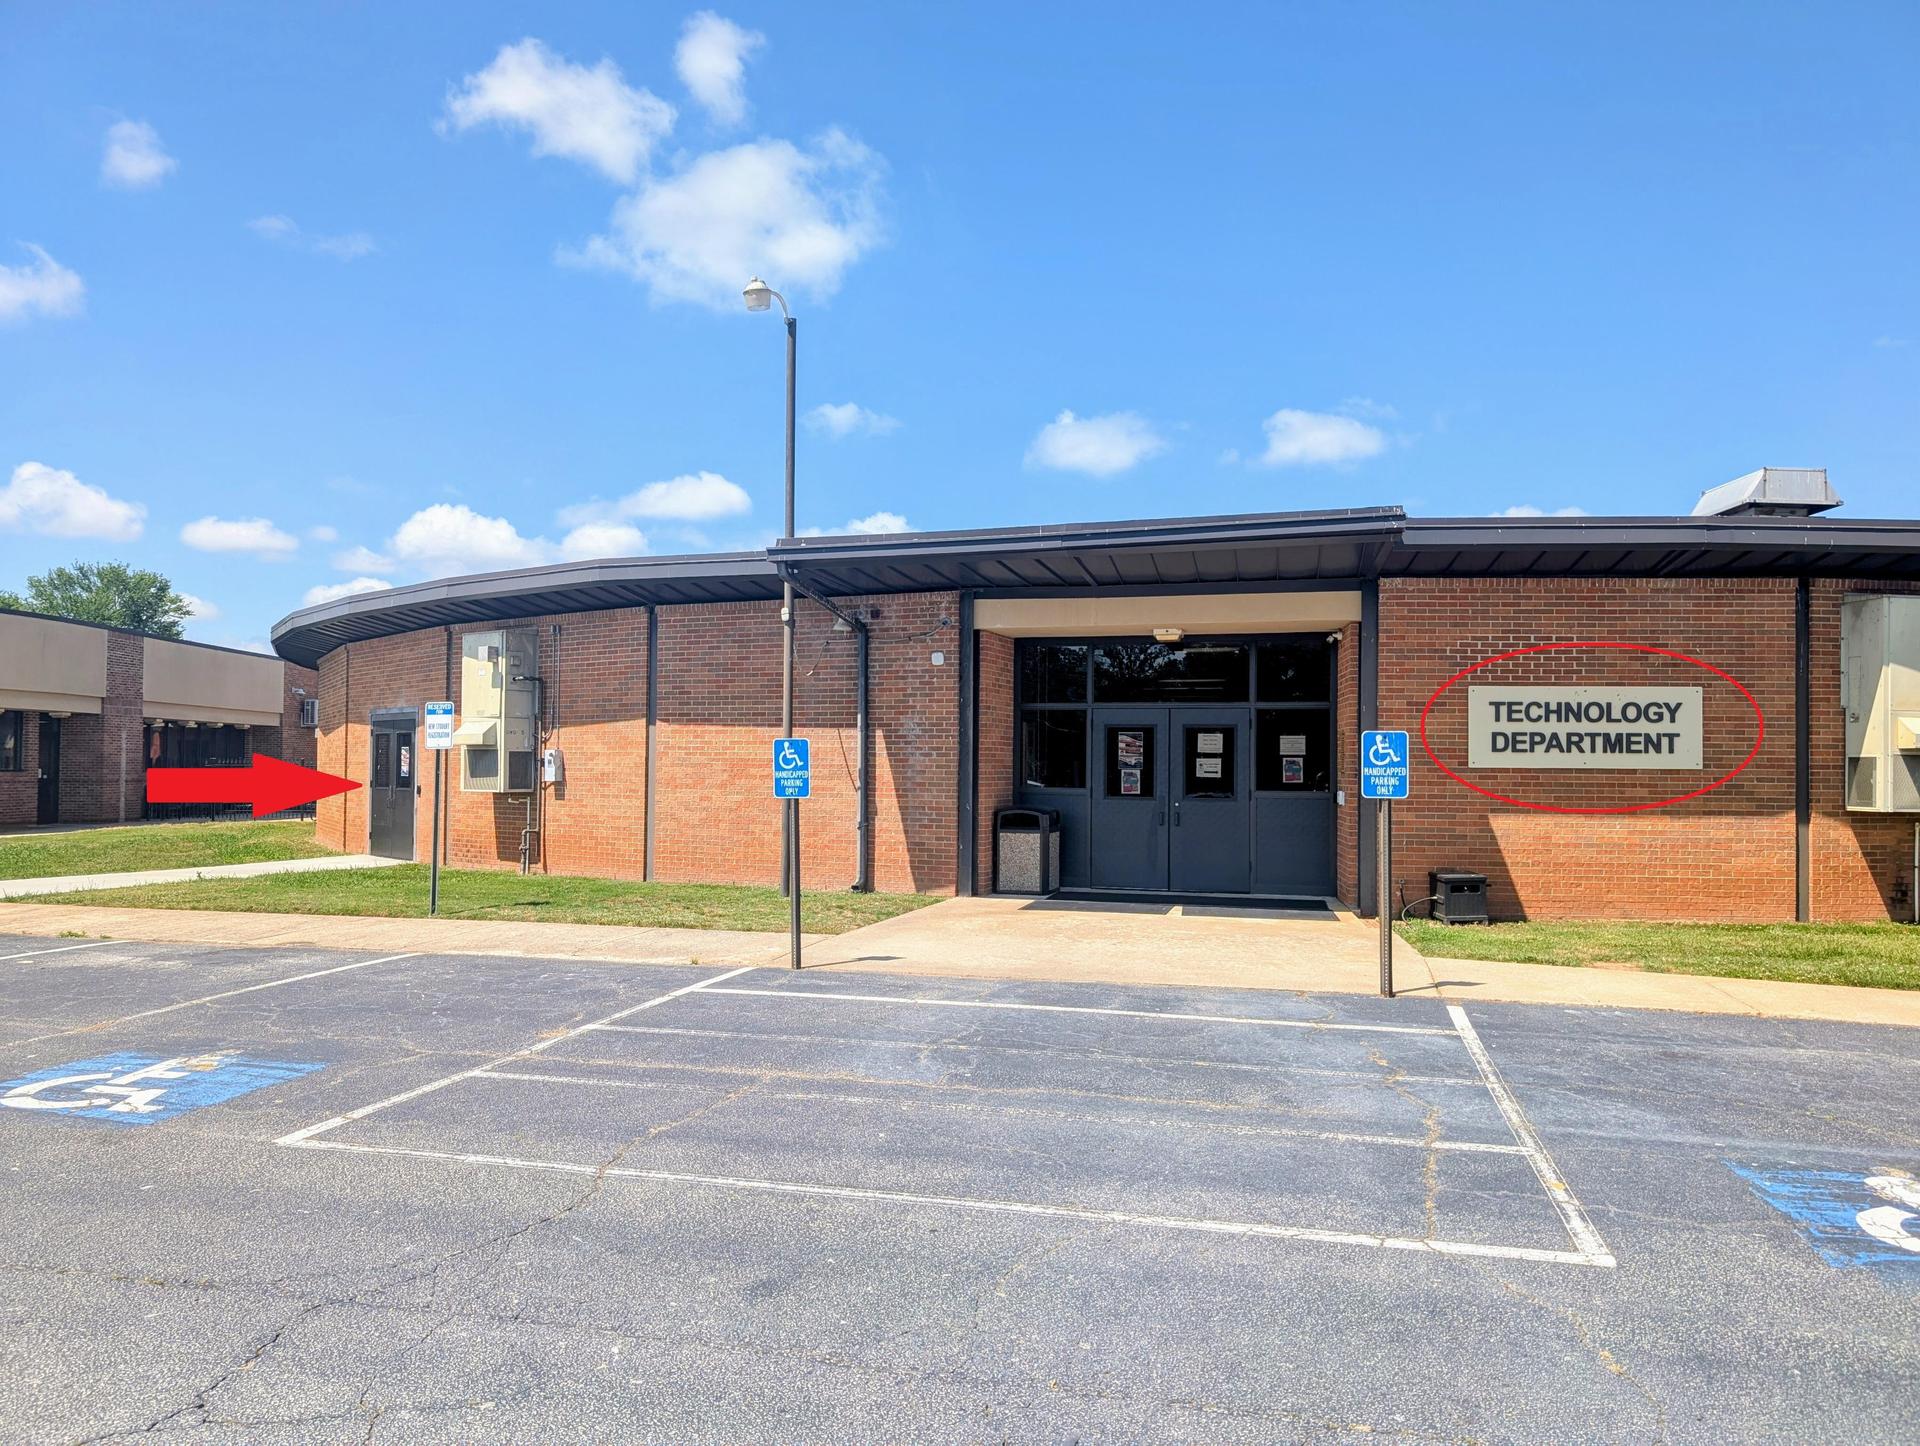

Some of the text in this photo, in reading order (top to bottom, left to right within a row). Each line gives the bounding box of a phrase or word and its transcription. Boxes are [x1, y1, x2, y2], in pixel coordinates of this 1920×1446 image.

[1489, 701, 1683, 723] TECHNOLOGY
[1491, 732, 1681, 754] DEPARTMENT
[775, 770, 809, 779] HANDICAPPED
[1364, 767, 1407, 776] HANDICAPPED
[780, 778, 804, 787] PARKING
[1370, 776, 1400, 785] PARKING
[1376, 786, 1394, 795] ONLY
